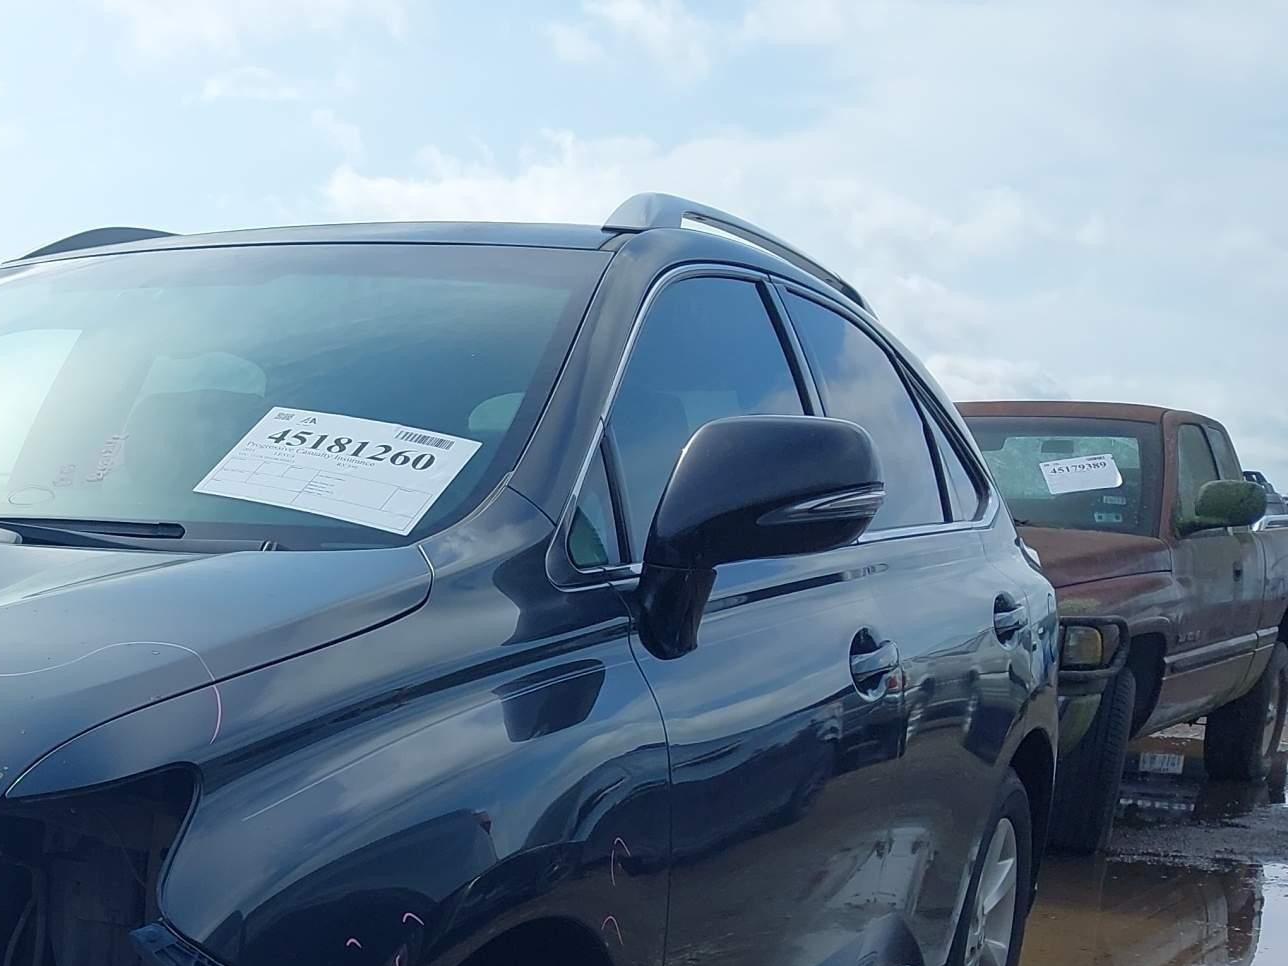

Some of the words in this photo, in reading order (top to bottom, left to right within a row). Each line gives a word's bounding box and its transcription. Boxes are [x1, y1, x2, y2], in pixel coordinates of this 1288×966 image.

[268, 428, 436, 470] 45181260
[296, 447, 331, 459] Casualty
[334, 454, 376, 467] Insurance
[1050, 461, 1107, 474] 45179389
